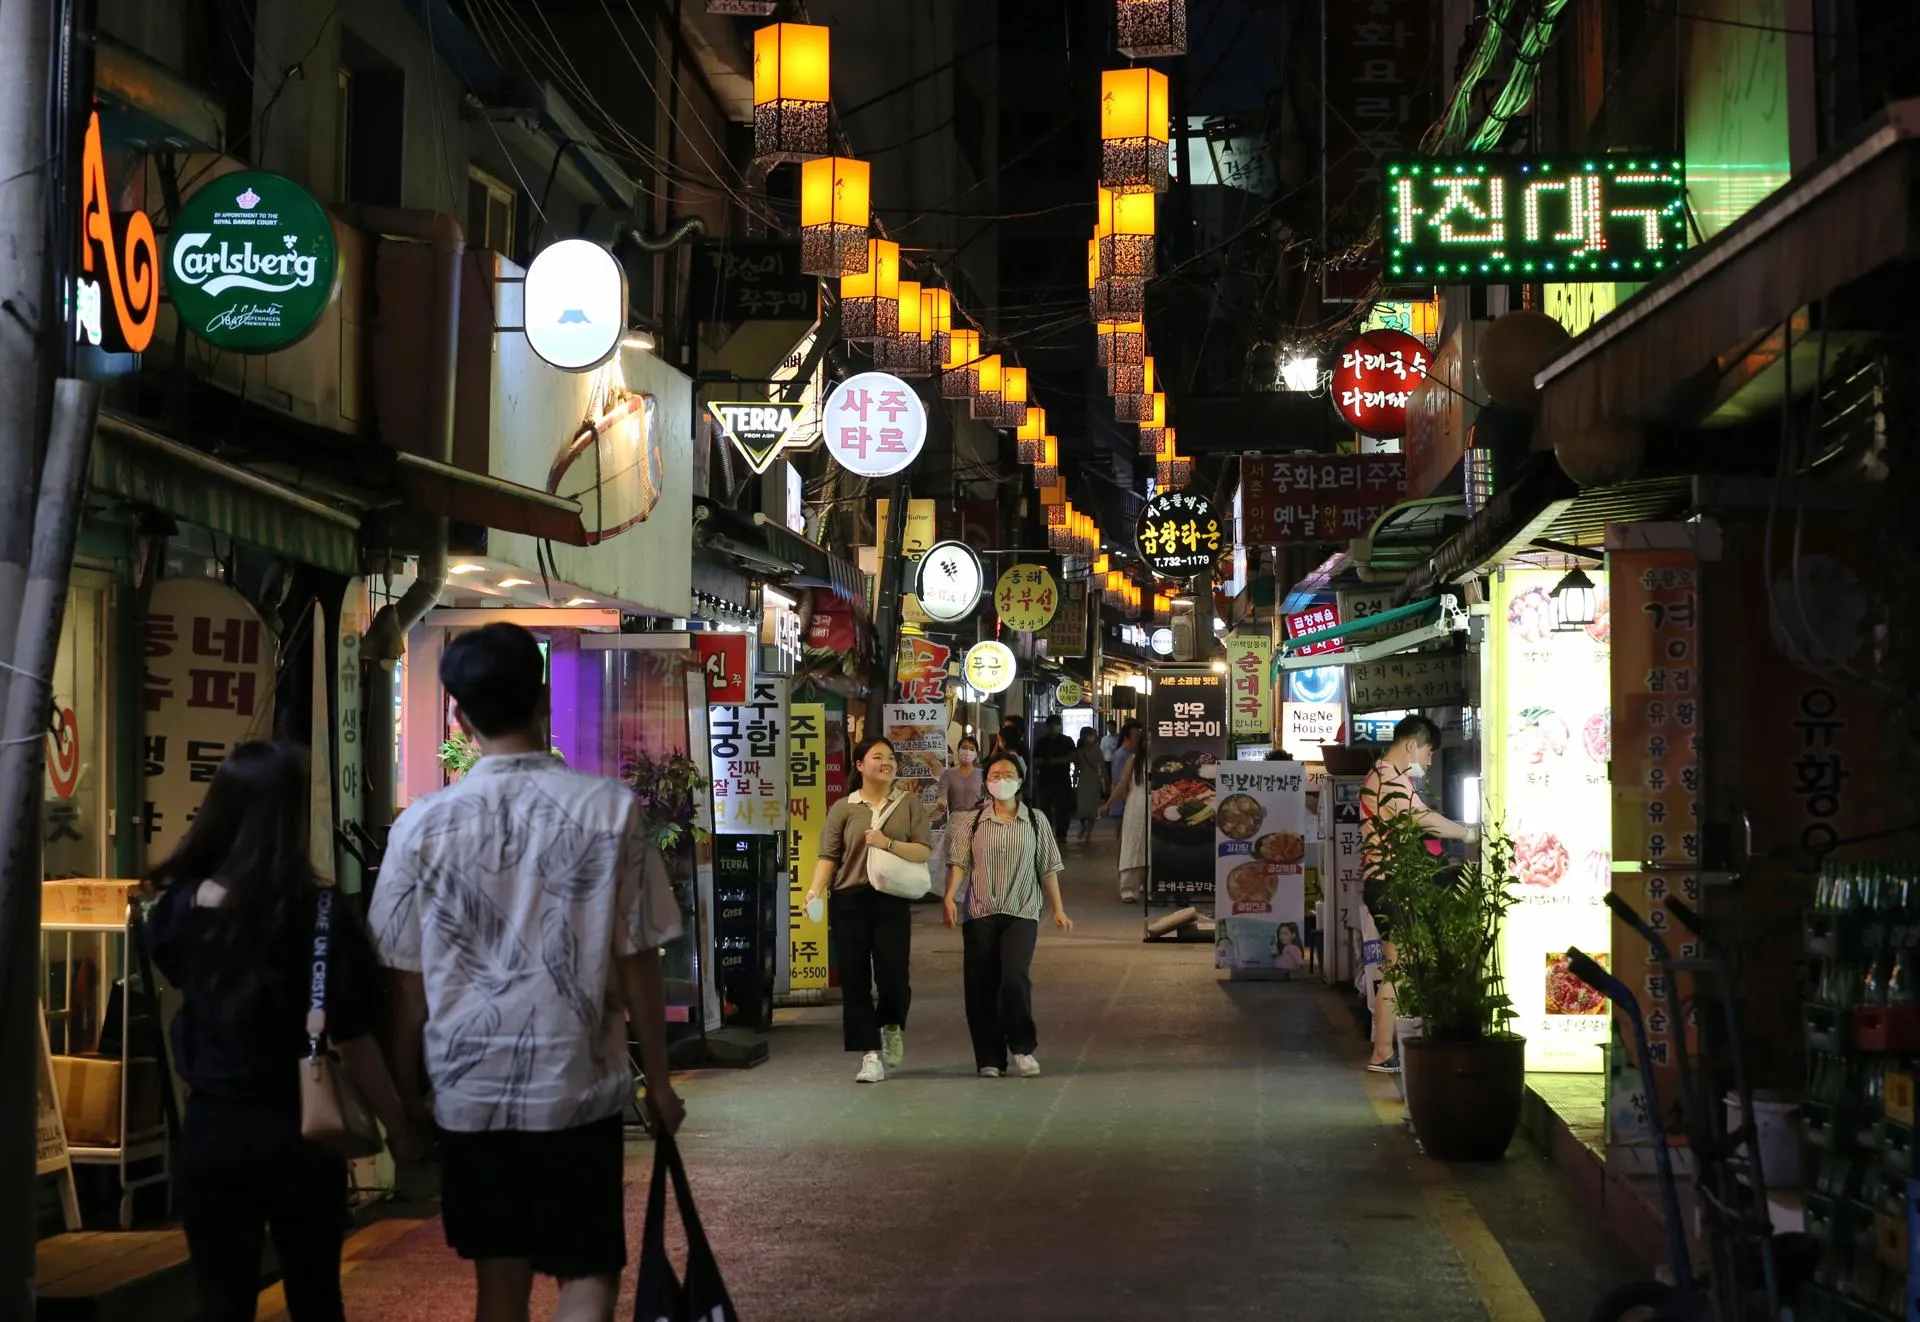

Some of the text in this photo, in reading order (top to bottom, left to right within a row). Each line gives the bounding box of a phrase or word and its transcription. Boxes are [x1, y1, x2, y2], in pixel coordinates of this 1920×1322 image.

[173, 233, 317, 288] Carlsberg
[1342, 349, 1427, 380] 다래국수
[839, 388, 909, 422] 사주
[1342, 387, 1414, 417] 다래짜
[720, 407, 797, 437] TERRA
[840, 426, 908, 460] 타로
[1272, 462, 1361, 494] 중화요리
[1273, 504, 1319, 537] 옛날
[1139, 519, 1221, 555] 곱창타운
[1154, 555, 1209, 567] T.732-1179
[1006, 570, 1043, 585] 동해
[1000, 587, 1053, 613] 남부선
[1293, 608, 1335, 630] 곱창볶음
[972, 656, 1002, 677] 풍금
[1203, 677, 1219, 686] 맛집
[1235, 651, 1262, 718] 순대국
[894, 709, 937, 721] The 9.2
[1173, 702, 1205, 718] 한우
[1293, 710, 1333, 723] NagNe
[1158, 721, 1221, 737] 곱창구이
[1293, 722, 1333, 733] House
[711, 720, 780, 759] 궁합
[727, 760, 761, 778] 진짜
[1221, 773, 1302, 792] 털보네감자탕
[720, 858, 748, 870] TERRA
[790, 967, 827, 979] 6-5500
